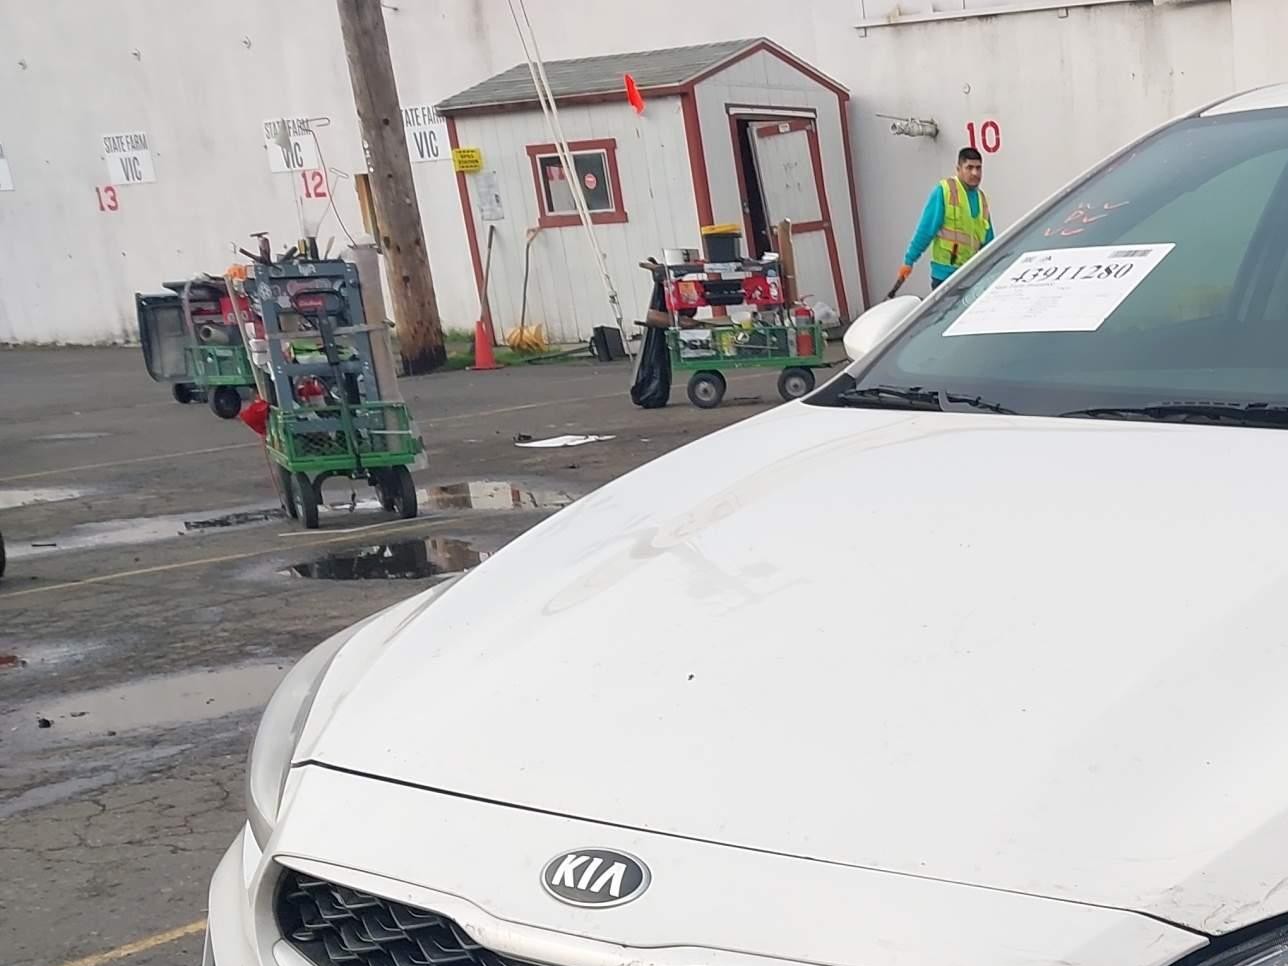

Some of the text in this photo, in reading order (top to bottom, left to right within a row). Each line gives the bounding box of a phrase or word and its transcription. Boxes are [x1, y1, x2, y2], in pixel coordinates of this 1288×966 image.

[413, 130, 439, 159] VIC
[967, 121, 1001, 153] 10
[120, 156, 143, 181] VIC
[281, 142, 304, 169] VIC
[301, 171, 327, 198] 12
[95, 186, 119, 212] 13
[1011, 262, 1134, 283] 43911280
[551, 854, 628, 898] KIA
